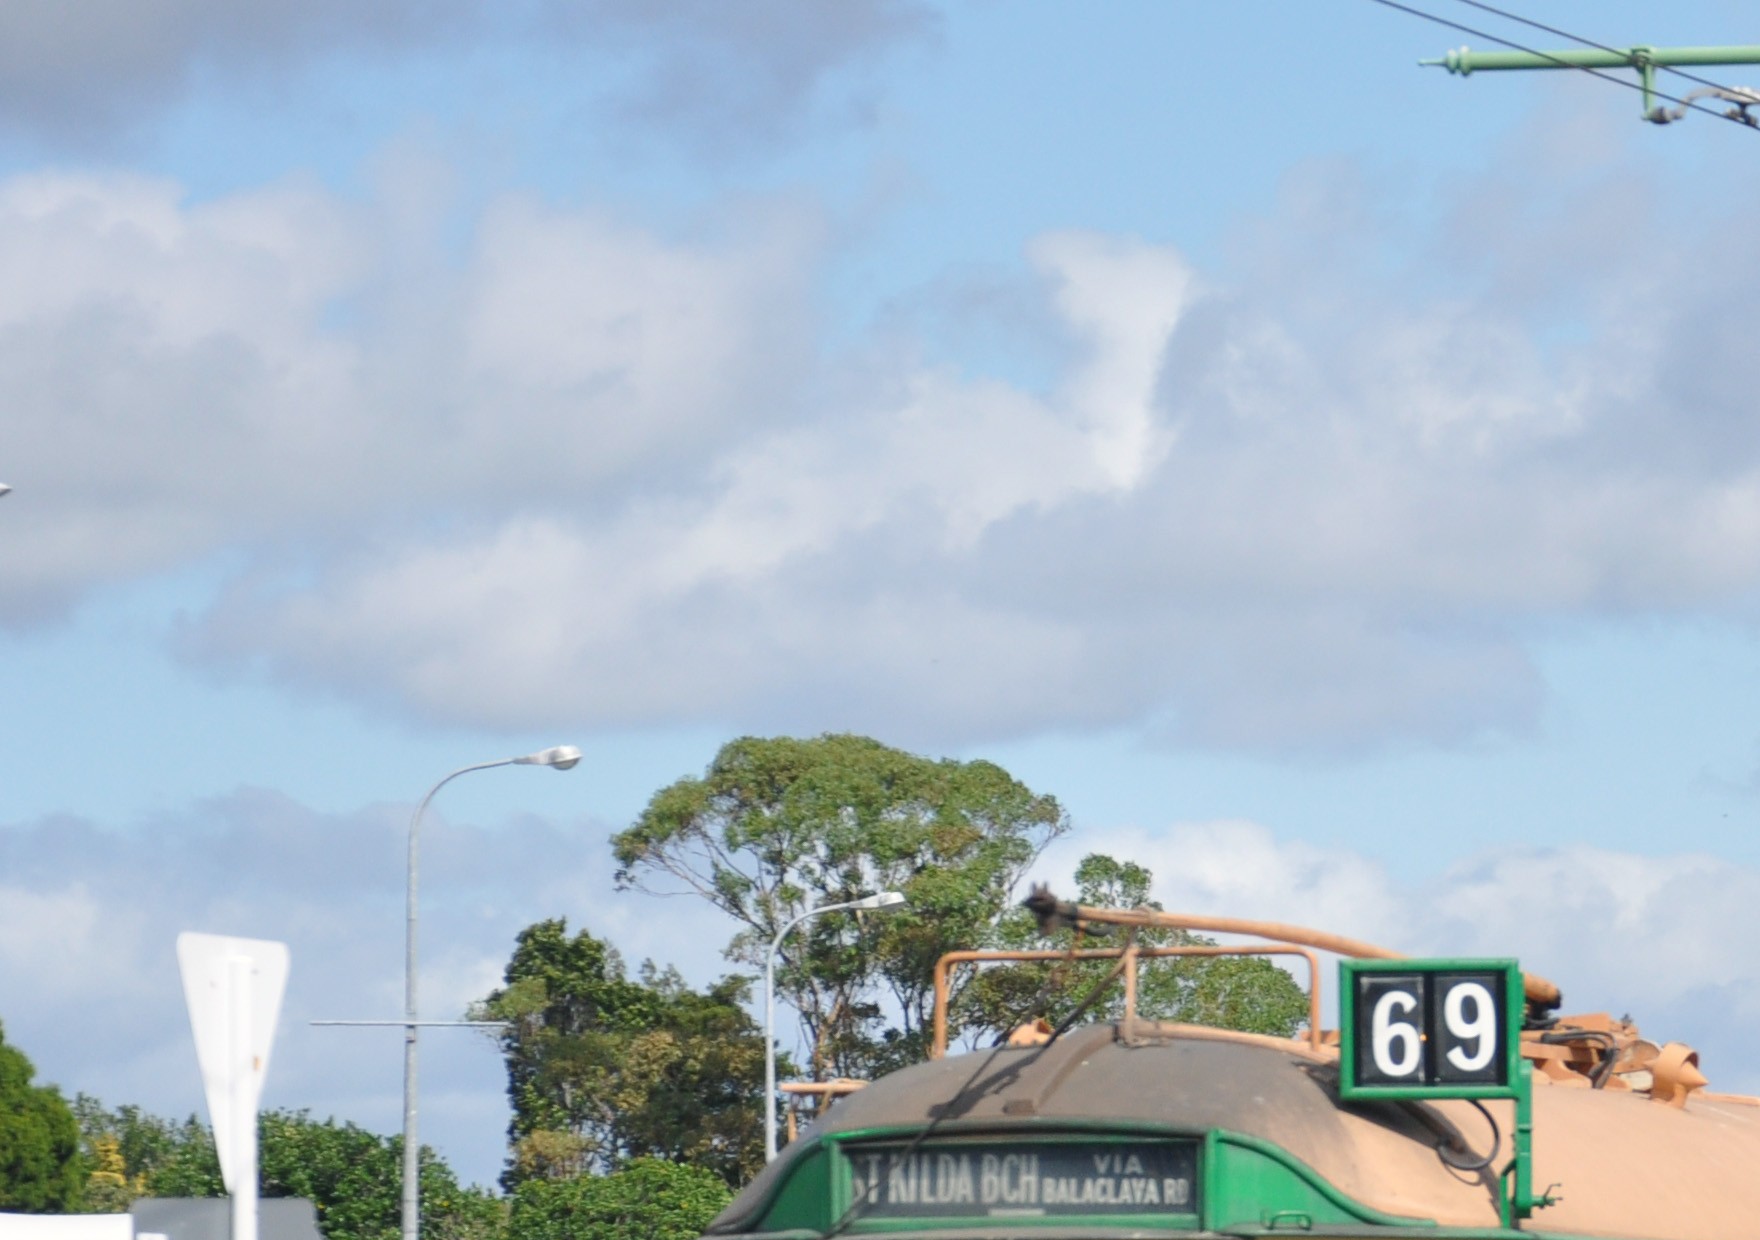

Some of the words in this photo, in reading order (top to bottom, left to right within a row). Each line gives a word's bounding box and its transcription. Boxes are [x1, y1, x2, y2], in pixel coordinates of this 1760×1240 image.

[1372, 982, 1497, 1077] 69
[888, 1153, 975, 1204] KILDA
[981, 1153, 1040, 1205] BCH
[1093, 1153, 1144, 1175] VIA
[1042, 1177, 1160, 1205] BALACLAVA
[1163, 1178, 1190, 1205] RD
